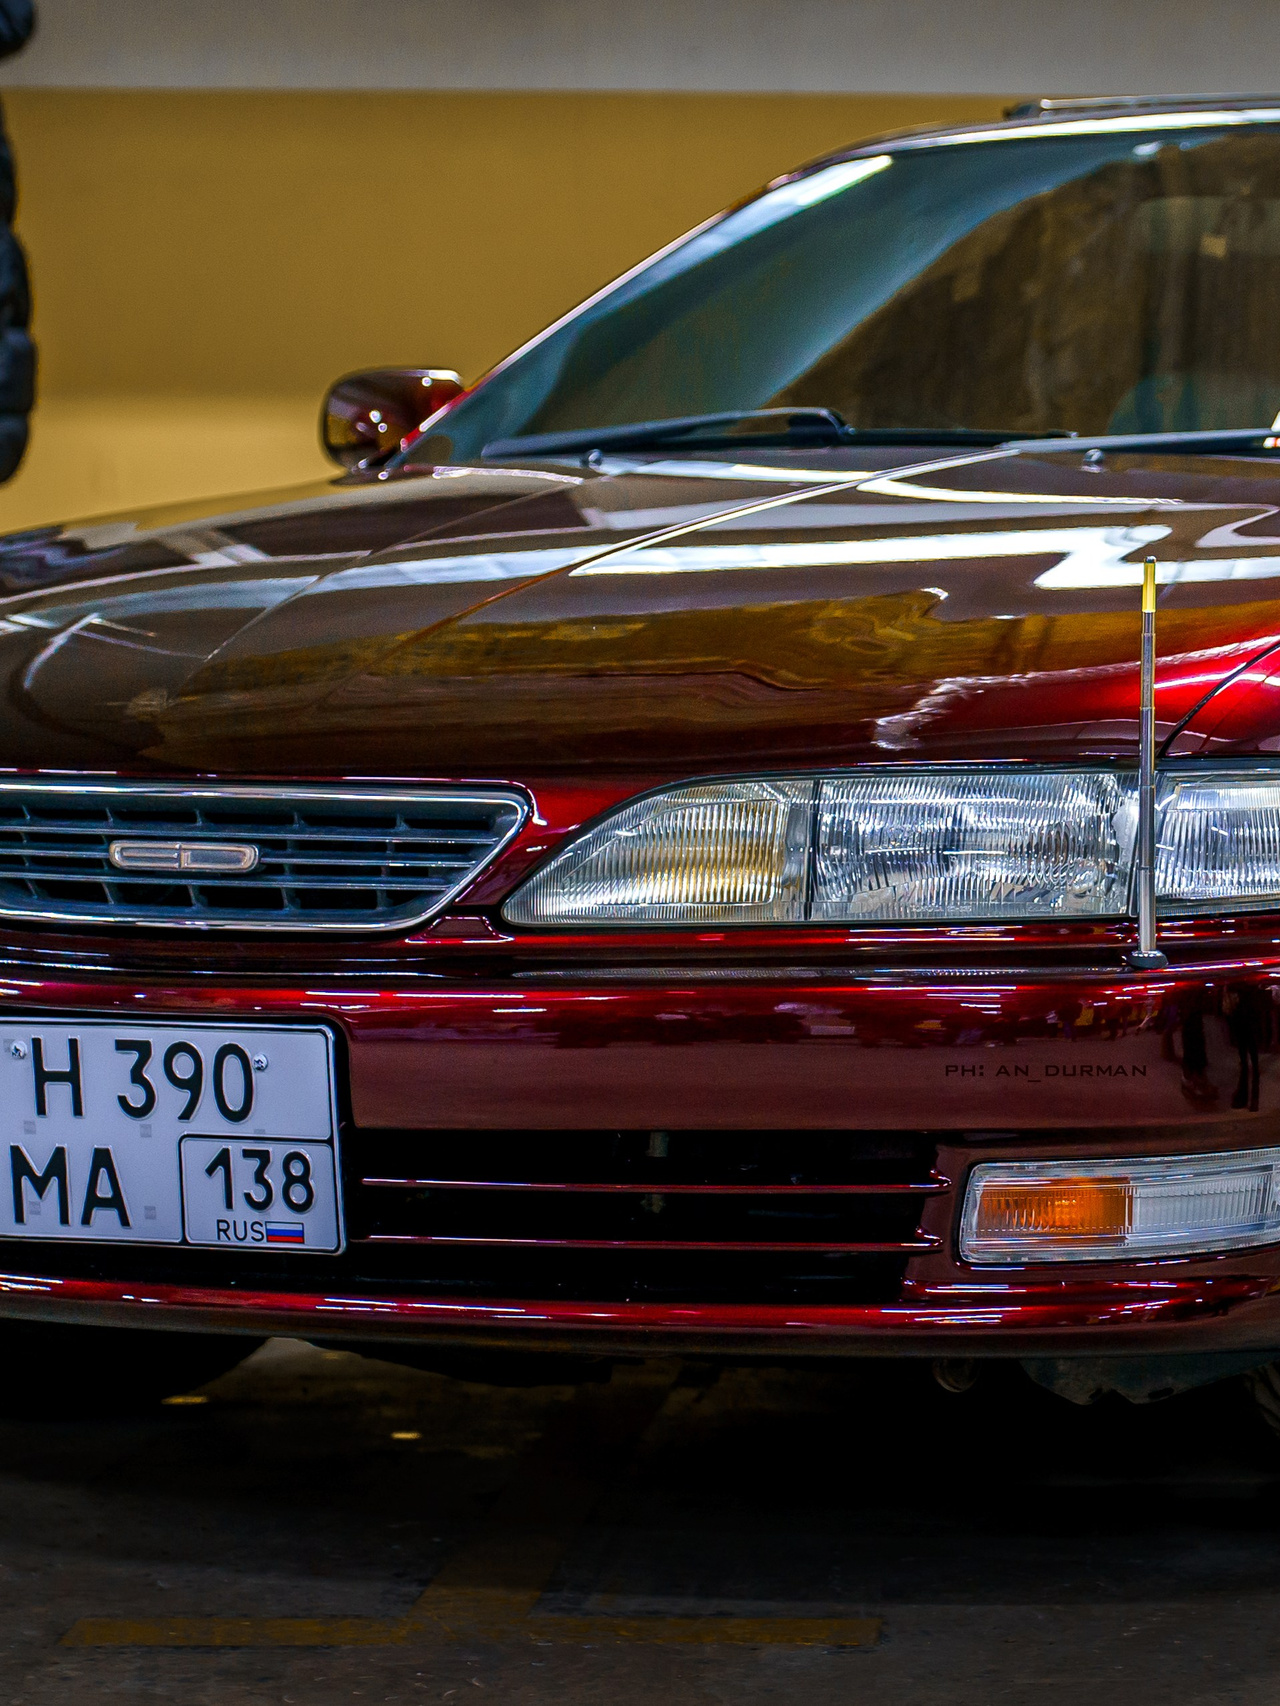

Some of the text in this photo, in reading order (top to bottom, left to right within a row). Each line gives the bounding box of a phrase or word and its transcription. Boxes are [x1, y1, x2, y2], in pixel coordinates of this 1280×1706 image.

[31, 1036, 254, 1124] H 390
[10, 1144, 315, 1229] MA 138
[216, 1219, 265, 1243] RUS
